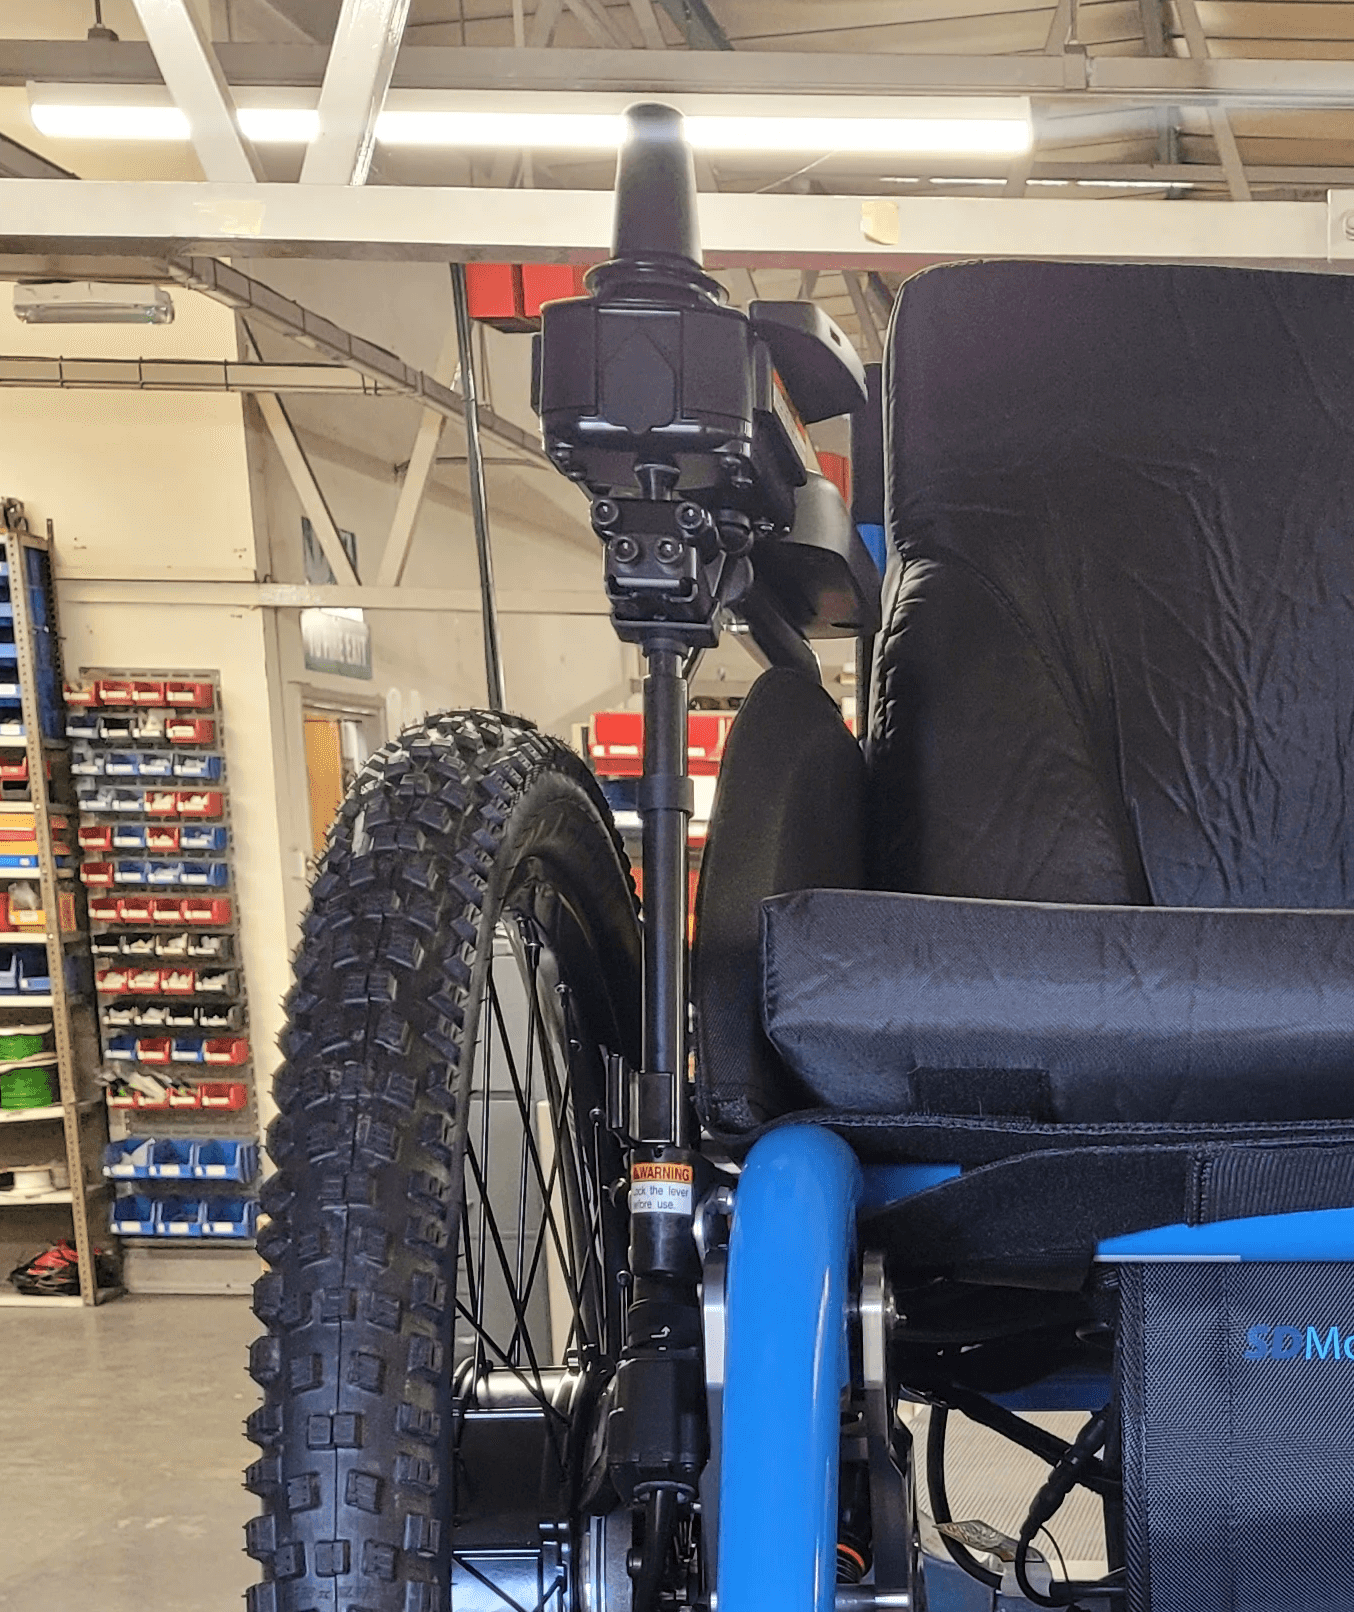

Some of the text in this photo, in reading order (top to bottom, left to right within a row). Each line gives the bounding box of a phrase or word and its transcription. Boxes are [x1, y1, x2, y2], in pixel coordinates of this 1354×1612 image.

[638, 1165, 690, 1182] WARNING
[650, 1185, 664, 1196] the
[668, 1185, 690, 1198] lever
